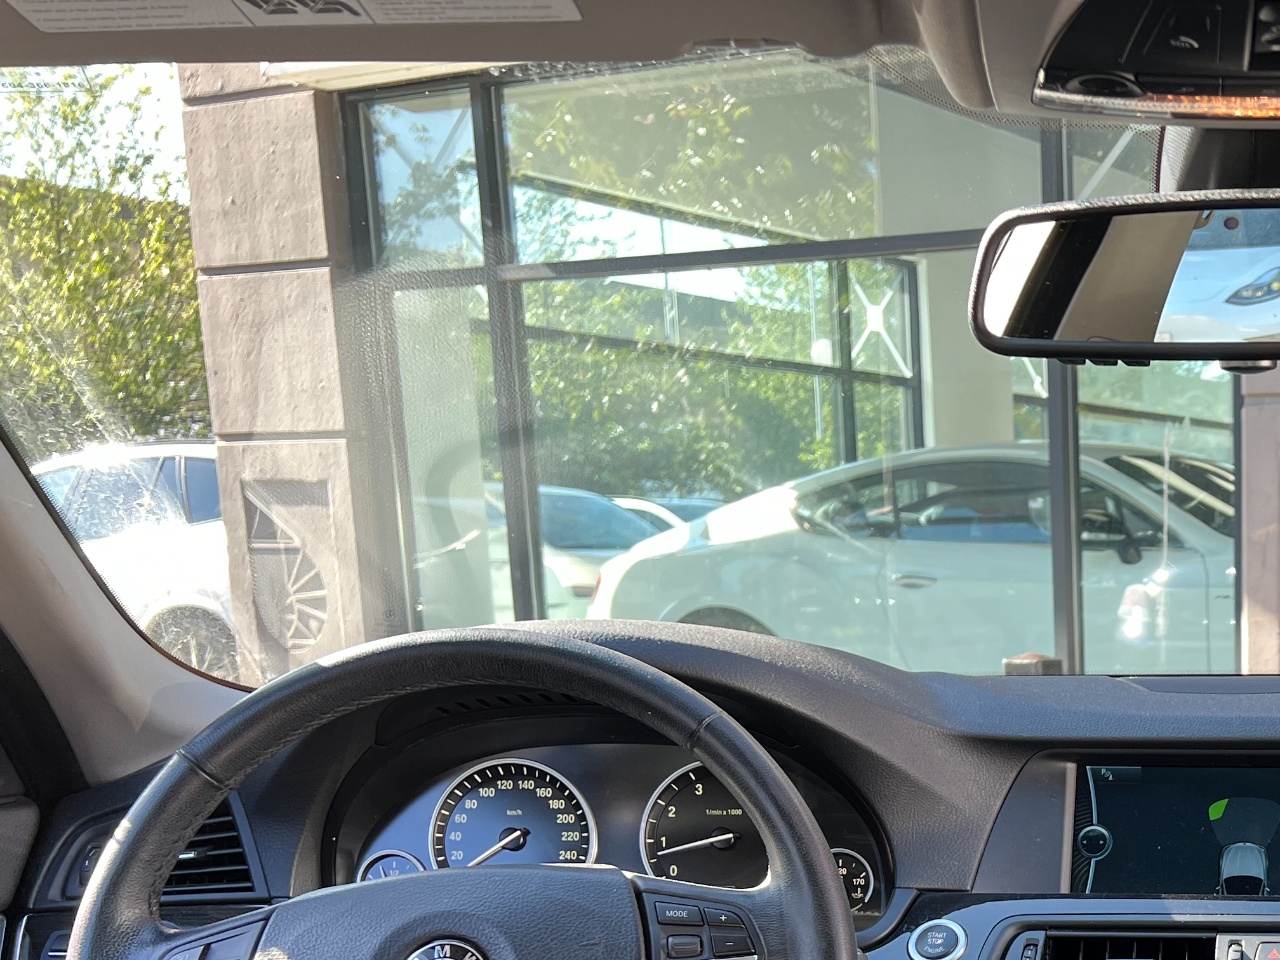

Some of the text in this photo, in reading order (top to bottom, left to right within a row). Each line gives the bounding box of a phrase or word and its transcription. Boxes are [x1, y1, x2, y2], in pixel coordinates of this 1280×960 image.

[496, 780, 513, 790] 120
[518, 780, 535, 790] 140
[694, 783, 703, 795] 3
[479, 787, 496, 798] 100
[535, 787, 552, 798] 160
[465, 799, 478, 809] 80
[548, 799, 565, 809] 180
[668, 805, 676, 818] 2
[455, 814, 467, 823] 60
[556, 814, 575, 823] 200
[449, 832, 461, 841] 40
[561, 832, 580, 841] 220
[660, 836, 666, 848] 1
[451, 850, 464, 860] 20
[559, 850, 578, 860] 240
[669, 865, 678, 876] 0
[852, 878, 865, 886] 170
[665, 909, 689, 919] MODE
[927, 931, 947, 939] START
